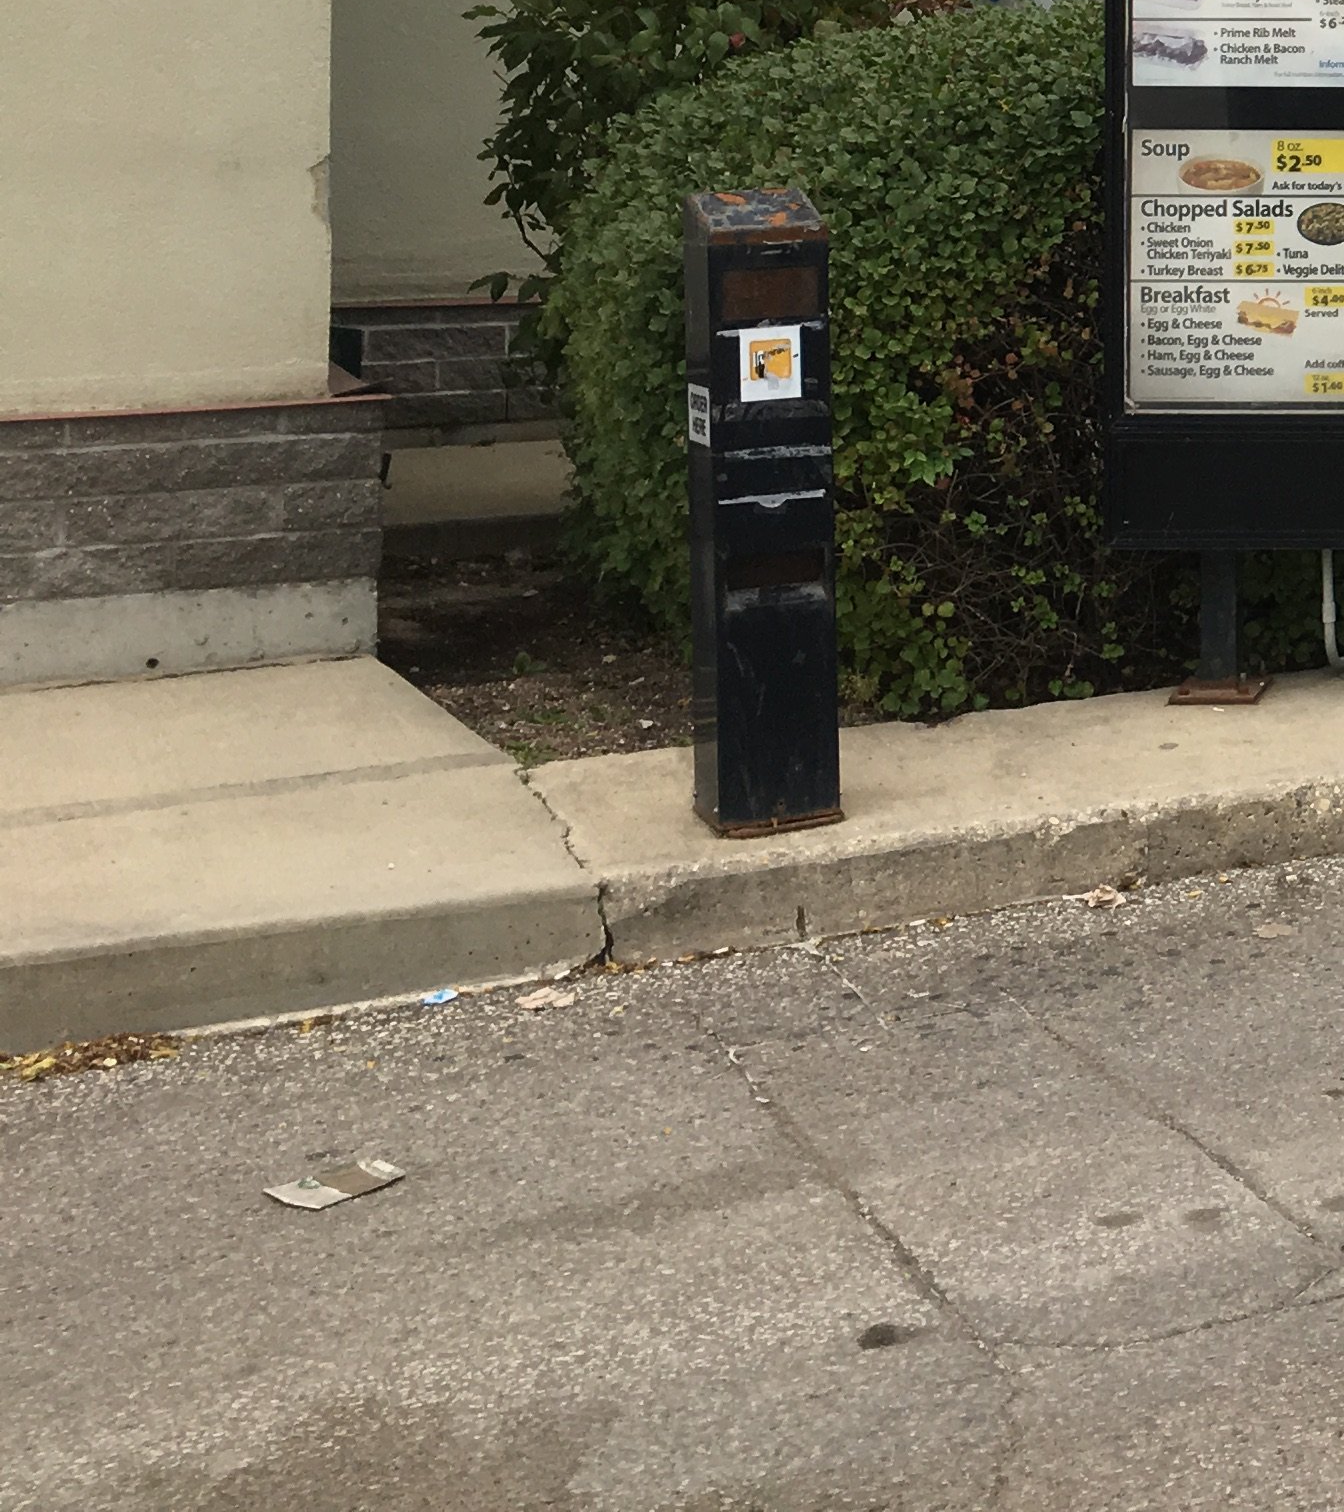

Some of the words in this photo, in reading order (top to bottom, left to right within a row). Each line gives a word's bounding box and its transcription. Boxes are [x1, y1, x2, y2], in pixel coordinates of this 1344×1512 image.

[1221, 29, 1250, 38] Prime
[1253, 28, 1270, 38] Rib
[1272, 28, 1295, 38] Melt
[1220, 44, 1261, 53] Chicken
[1264, 45, 1271, 53] &
[1274, 44, 1305, 53] Bacon
[1220, 56, 1252, 64] Ranch
[1255, 55, 1278, 64] Melt
[1141, 140, 1190, 160] Soup
[1277, 141, 1284, 151] 8
[1287, 142, 1303, 151] oz.
[1277, 154, 1322, 173] $2.50
[1272, 182, 1289, 190] Ask
[1291, 182, 1305, 190] for
[1308, 182, 1342, 192] today's
[1141, 200, 1227, 220] Chopped
[1233, 200, 1293, 217] Salads
[1147, 223, 1191, 233] Chicken
[1147, 238, 1178, 247] Sweet
[1181, 238, 1213, 247] Onion
[1147, 249, 1189, 259] Chicken
[1191, 249, 1232, 261] Teriyaki
[1284, 249, 1308, 259] Tuna
[1147, 266, 1184, 277] Turkey
[1188, 266, 1223, 276] Breast
[1283, 265, 1319, 277] Veggie
[1141, 287, 1230, 303] Breakfast
[1141, 305, 1158, 314] Egg
[1171, 305, 1188, 314] Egg
[1190, 305, 1216, 313] White
[1305, 309, 1338, 317] Served
[1148, 320, 1169, 331] Egg
[1172, 320, 1180, 329] &
[1183, 319, 1222, 329] Cheese
[1148, 336, 1184, 346] Bacon,
[1187, 336, 1208, 347] Egg
[1211, 336, 1219, 345] &
[1221, 336, 1262, 345] Cheese
[1148, 351, 1177, 362] Ham,
[1180, 351, 1200, 363] Egg
[1203, 351, 1212, 360] &
[1215, 351, 1254, 361] Cheese
[1305, 360, 1324, 369] Add
[1148, 366, 1196, 377] Sausage,
[1200, 366, 1220, 378] Egg
[1223, 366, 1232, 375] &
[1235, 366, 1274, 376] Cheese
